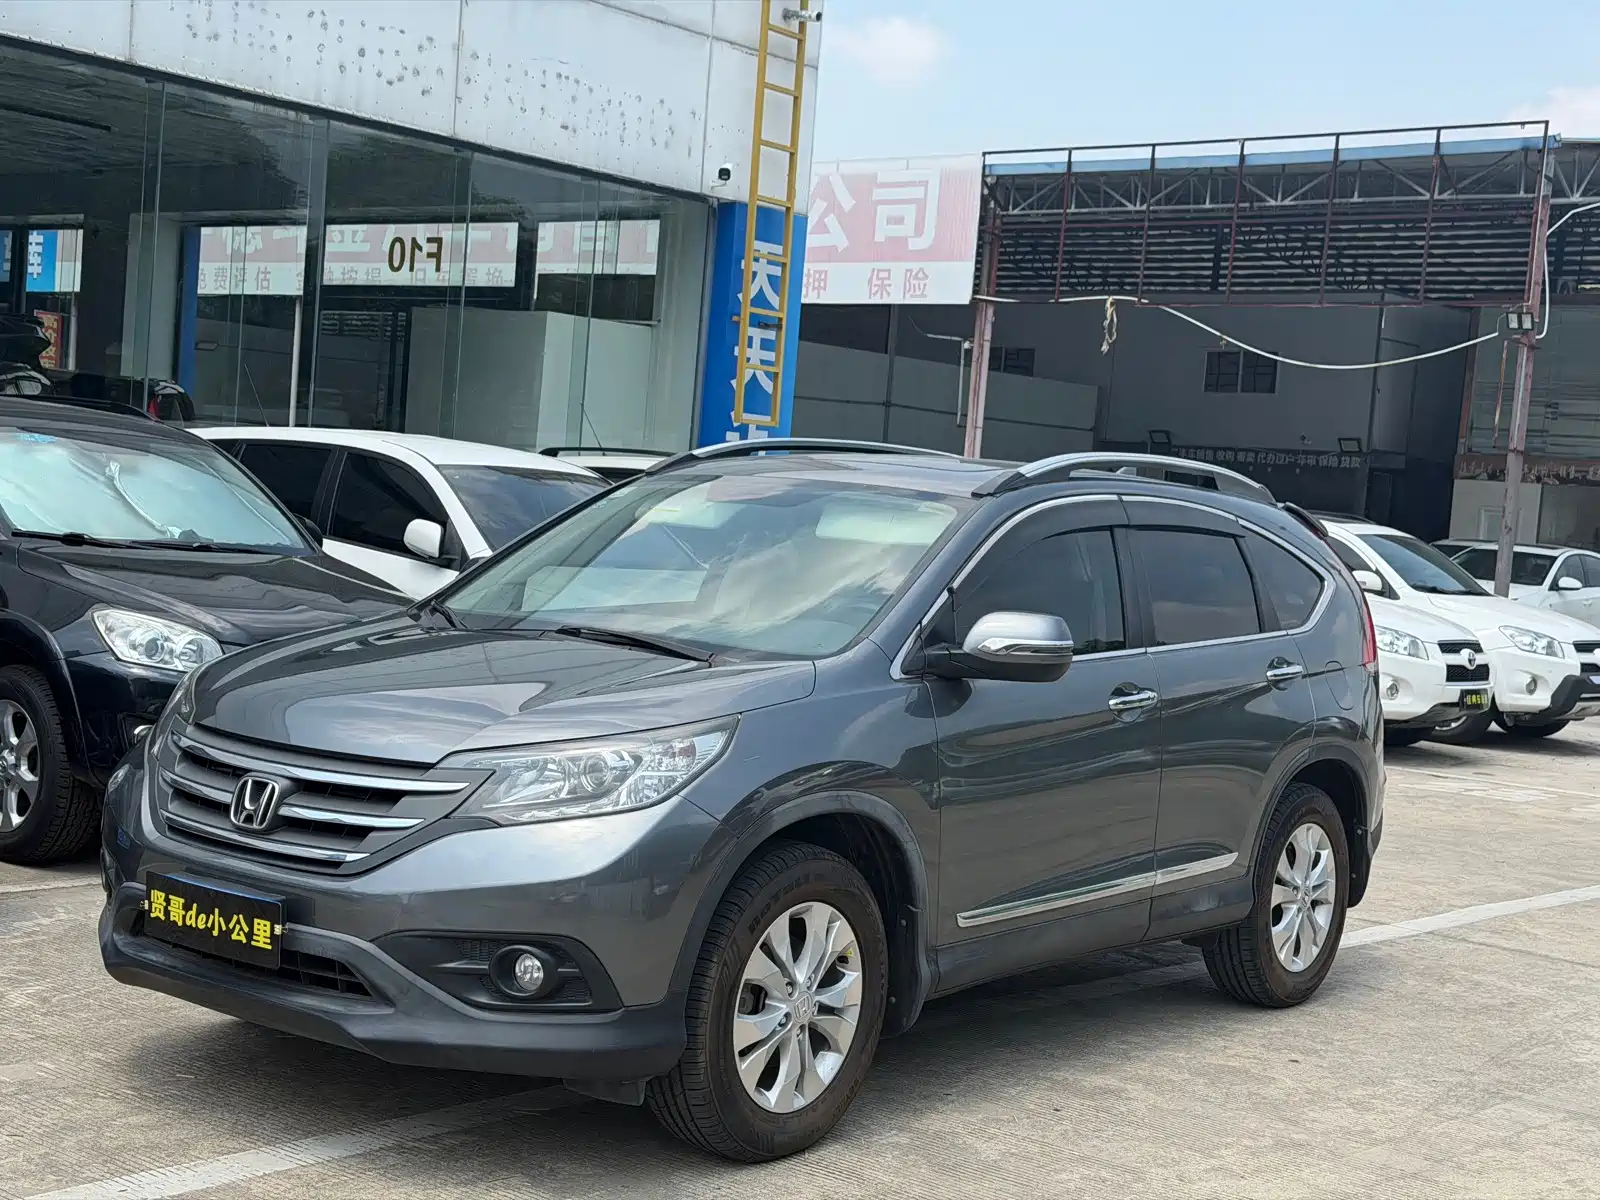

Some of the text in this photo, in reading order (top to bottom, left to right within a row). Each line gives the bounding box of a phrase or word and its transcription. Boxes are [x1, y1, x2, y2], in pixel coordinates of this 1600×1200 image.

[868, 266, 930, 300] 保险
[149, 889, 273, 950] 贤哥de小公里
